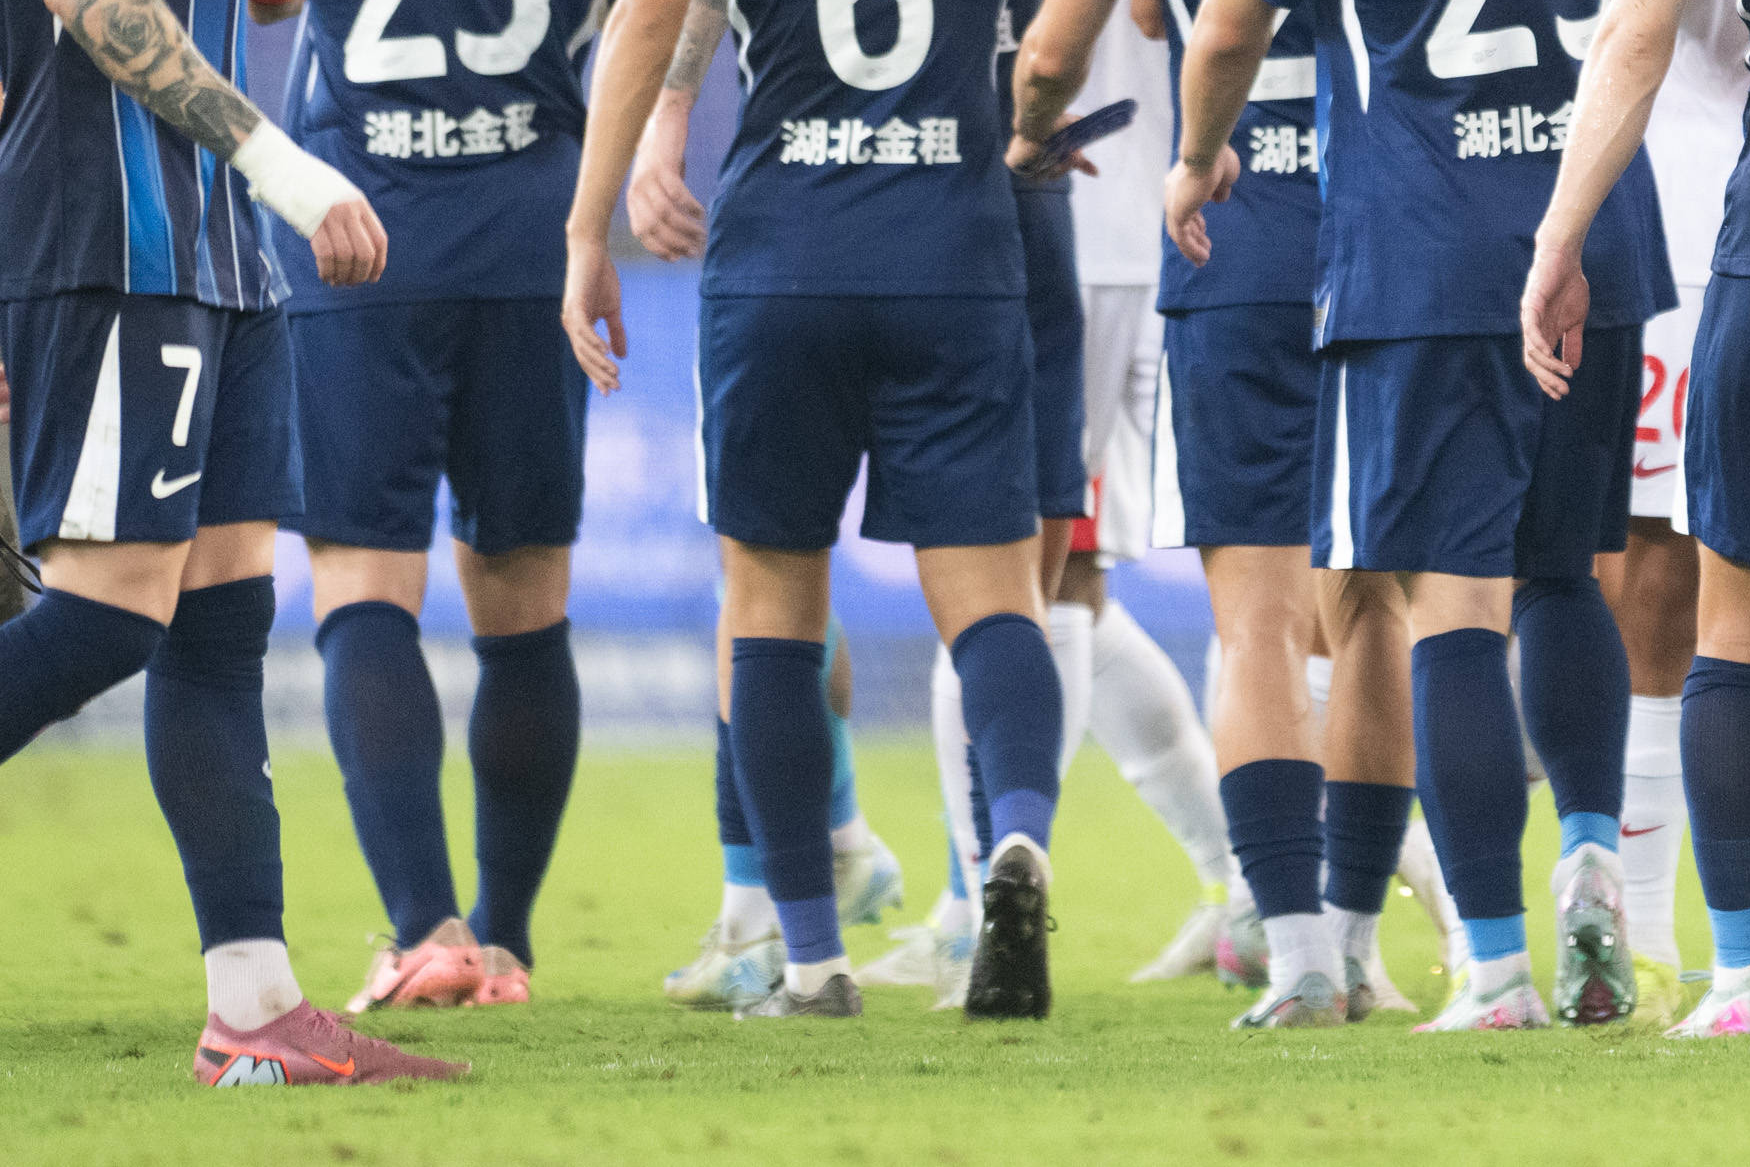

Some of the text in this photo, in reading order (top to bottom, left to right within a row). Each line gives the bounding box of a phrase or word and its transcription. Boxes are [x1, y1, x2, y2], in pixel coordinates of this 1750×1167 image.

[779, 117, 962, 166] 湖北金租
[160, 344, 203, 447] 7
